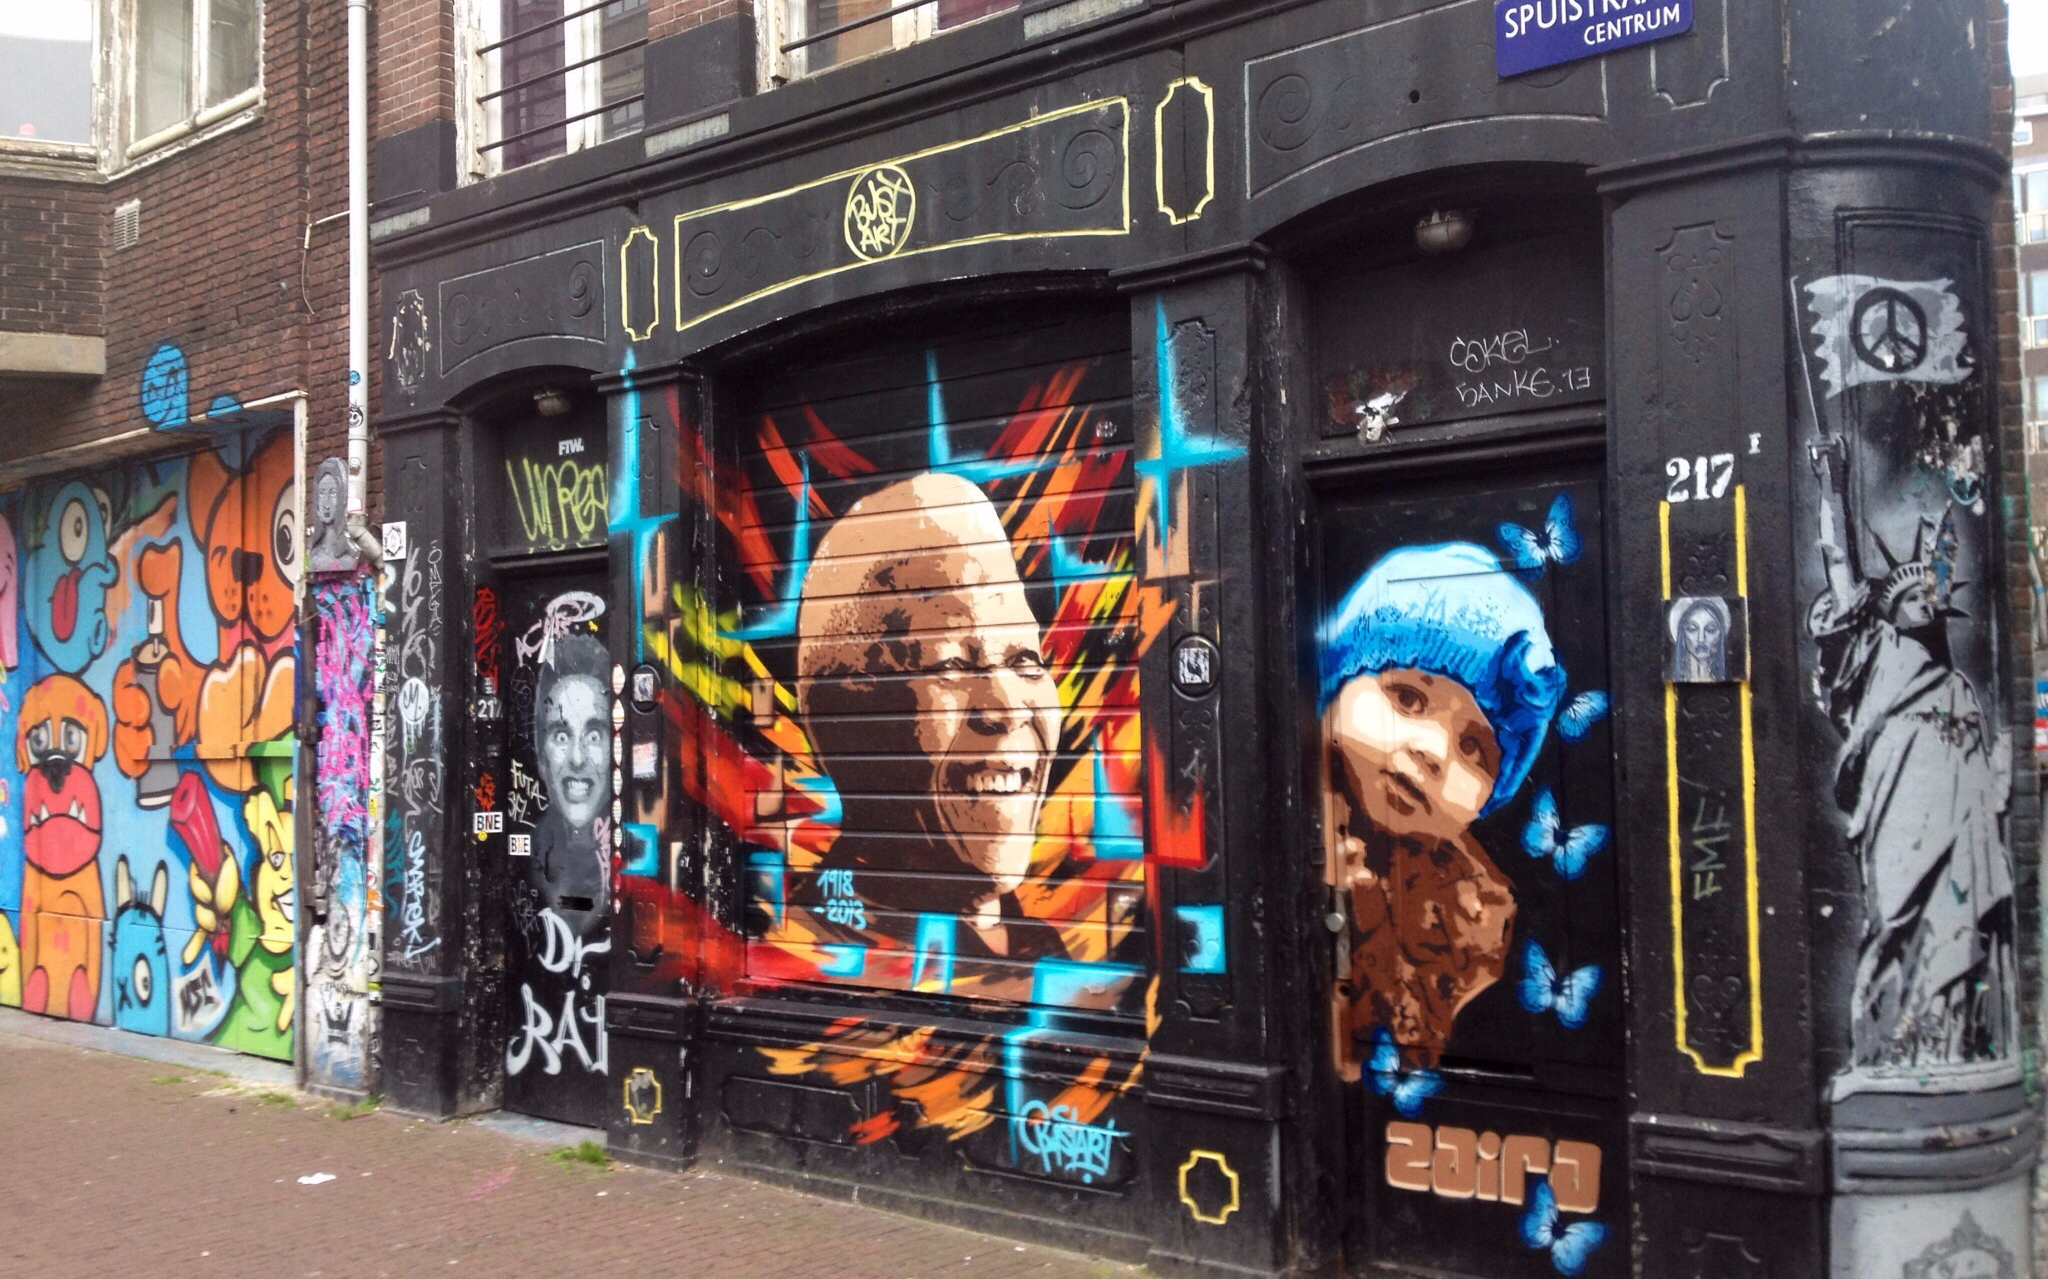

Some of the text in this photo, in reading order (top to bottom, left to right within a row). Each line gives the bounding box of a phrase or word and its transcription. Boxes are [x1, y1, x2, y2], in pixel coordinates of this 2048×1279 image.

[1505, 0, 1647, 38] SPUIST
[1584, 3, 1680, 45] CENTRUM
[1666, 453, 1735, 503] 217
[477, 814, 501, 831] BNE
[816, 868, 855, 898] 1918
[506, 983, 609, 1077] RAY
